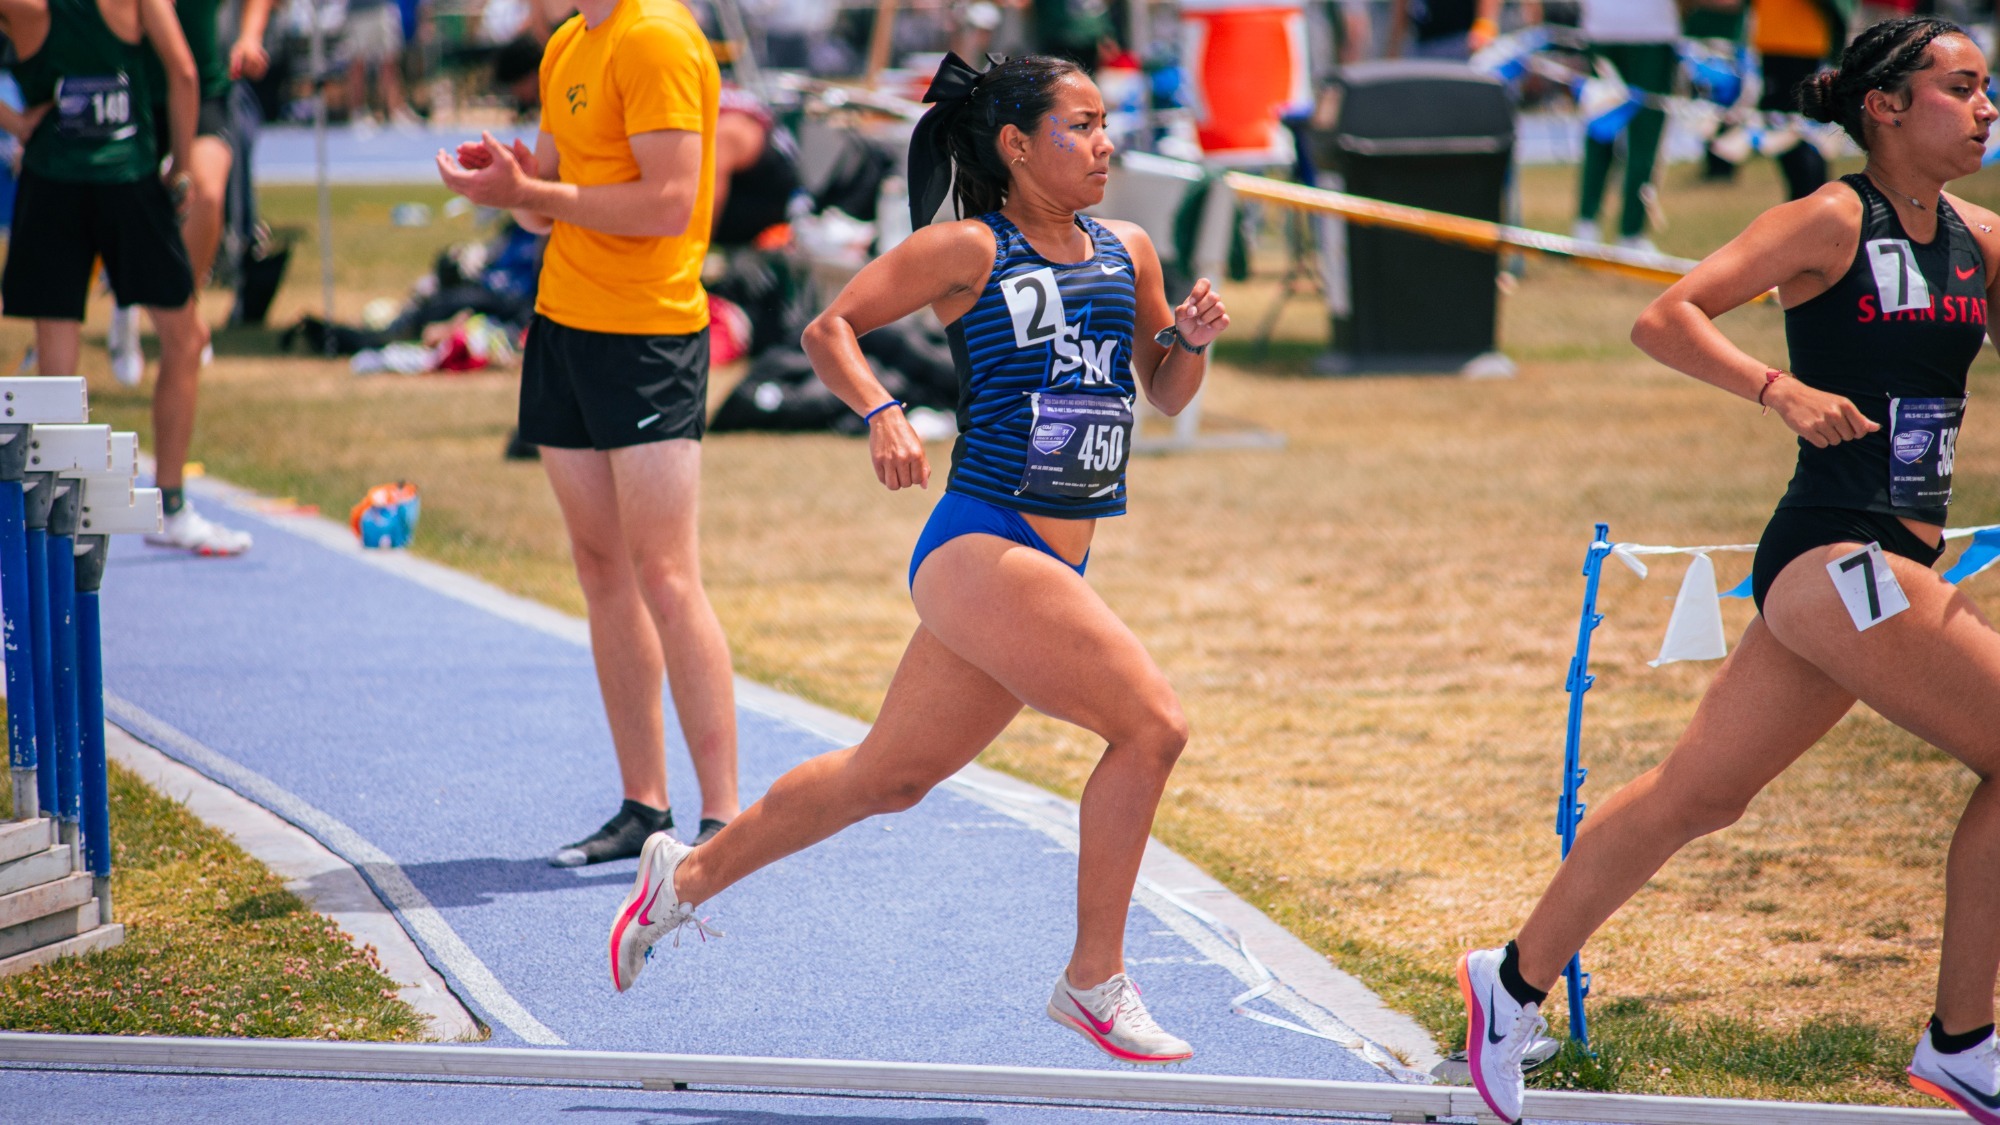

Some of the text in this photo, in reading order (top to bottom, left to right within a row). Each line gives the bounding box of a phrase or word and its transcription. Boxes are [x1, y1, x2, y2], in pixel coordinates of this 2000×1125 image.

[1878, 244, 1908, 306] 7
[1014, 277, 1056, 340] 2
[1051, 321, 1118, 384] SM
[1078, 424, 1124, 471] 450
[1839, 551, 1882, 621] 7
